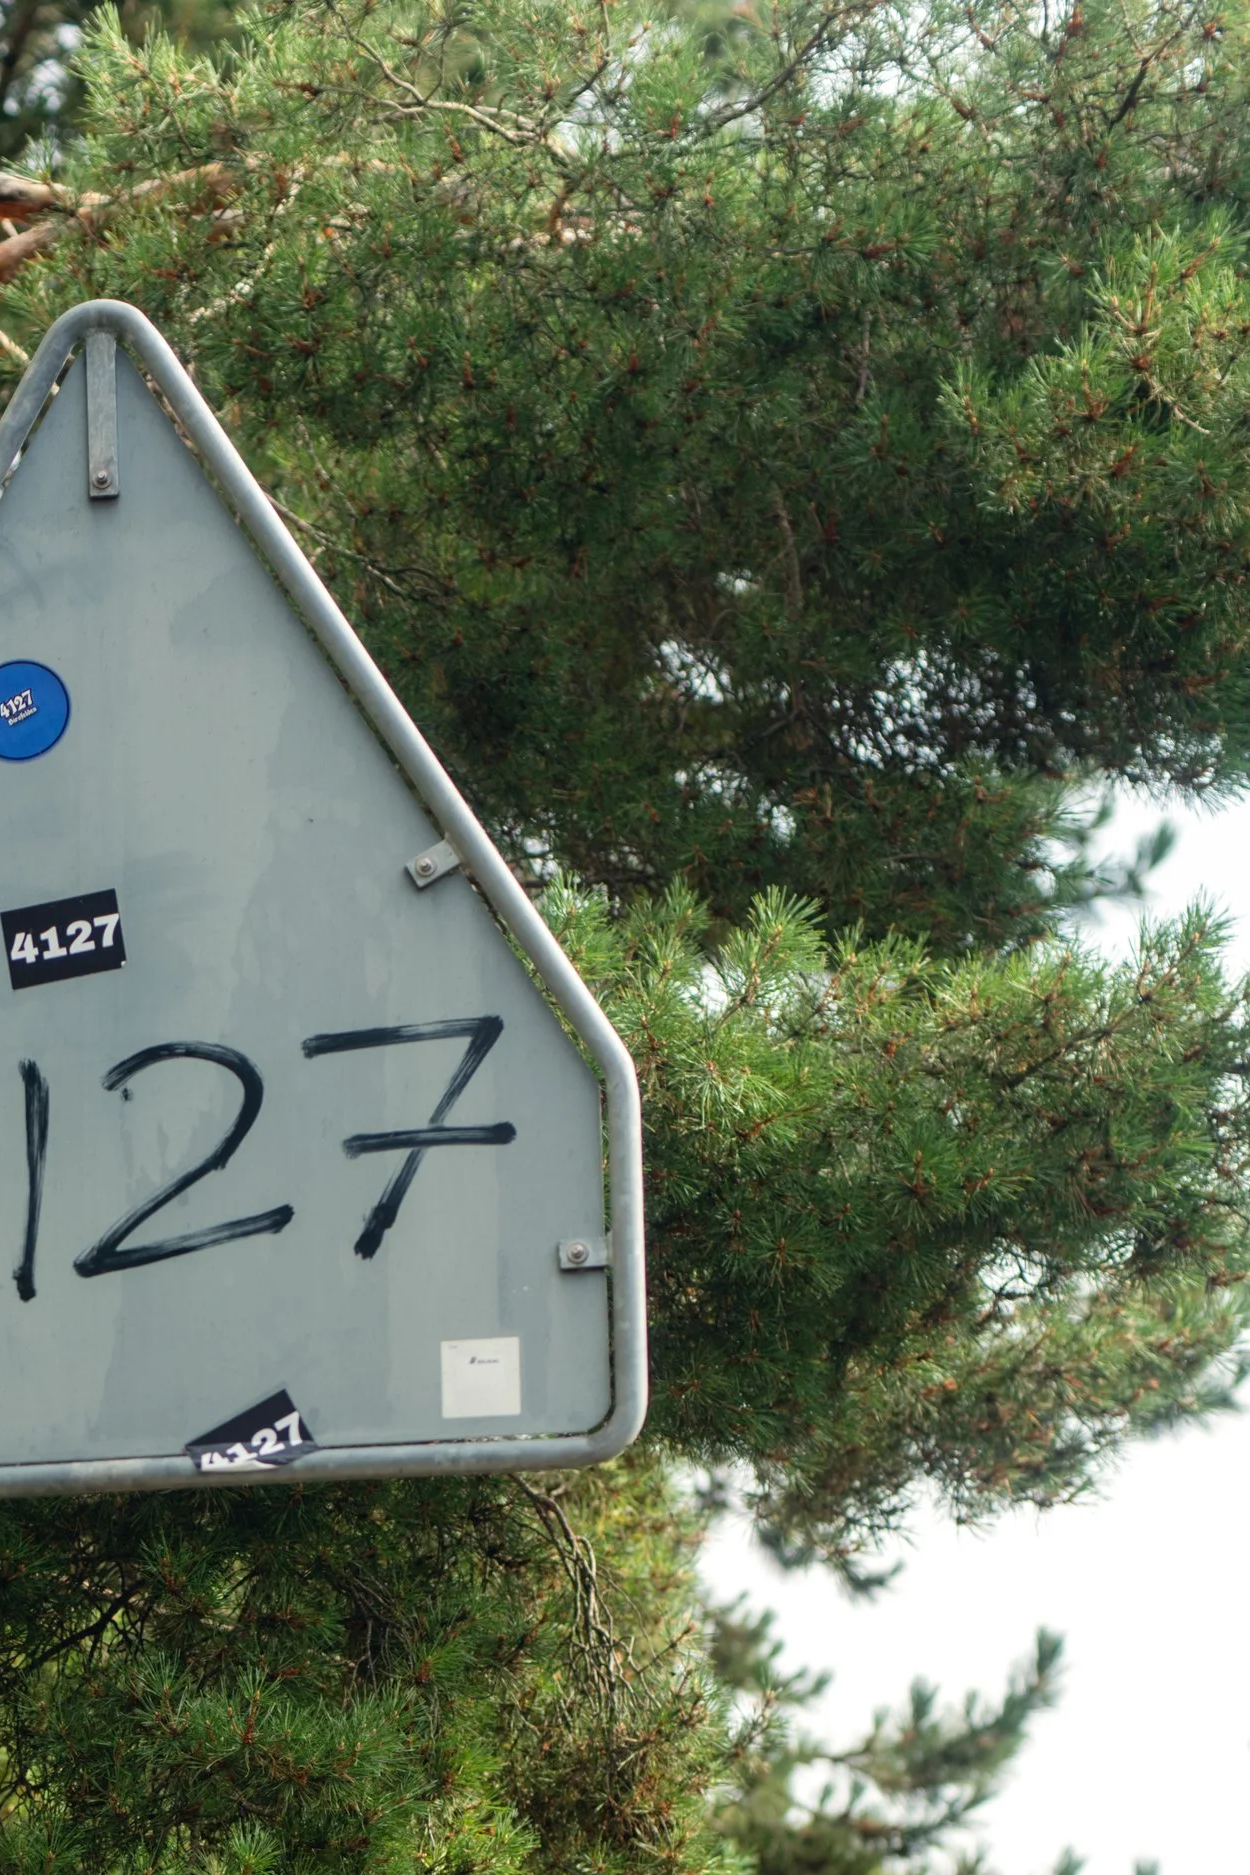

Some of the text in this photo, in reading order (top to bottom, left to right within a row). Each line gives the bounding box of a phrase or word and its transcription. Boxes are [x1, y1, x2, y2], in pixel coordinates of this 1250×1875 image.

[0, 688, 34, 719] 4127
[10, 913, 120, 964] 4127
[200, 1410, 303, 1471] 4127
